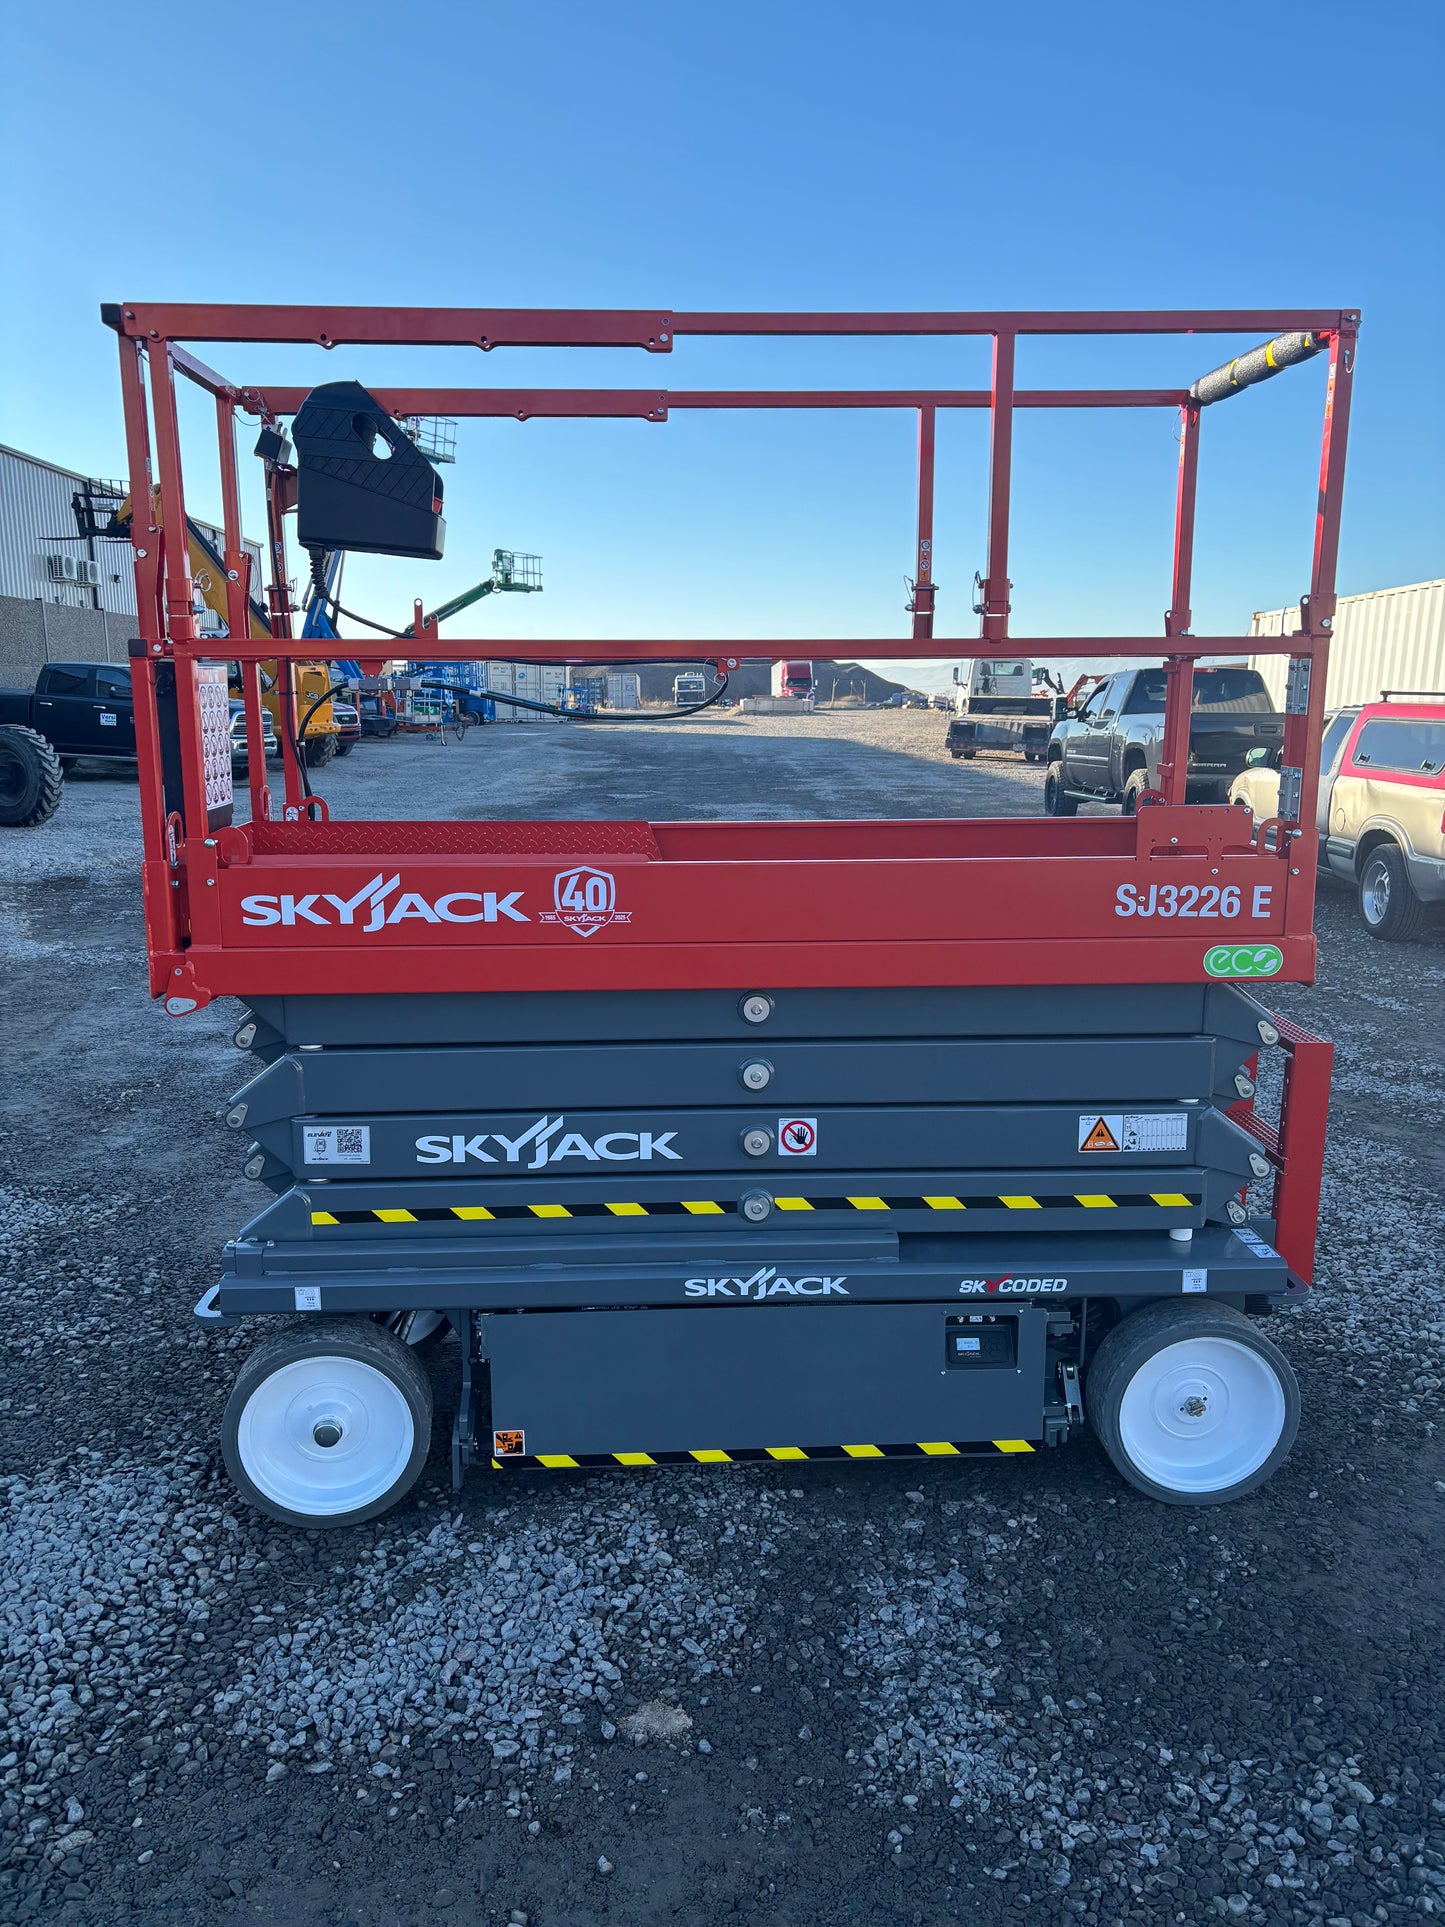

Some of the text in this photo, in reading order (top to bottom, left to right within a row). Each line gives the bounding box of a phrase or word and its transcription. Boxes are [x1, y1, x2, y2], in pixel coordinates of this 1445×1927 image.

[240, 873, 532, 932] SKYJACK
[561, 875, 607, 911] 40
[1114, 883, 1273, 918] SJ3226 E
[563, 914, 606, 923] SKYJACK
[415, 1115, 684, 1169] SKYJACK
[684, 1266, 850, 1300] SKYJACK
[959, 1272, 1068, 1293] SKYCODED
